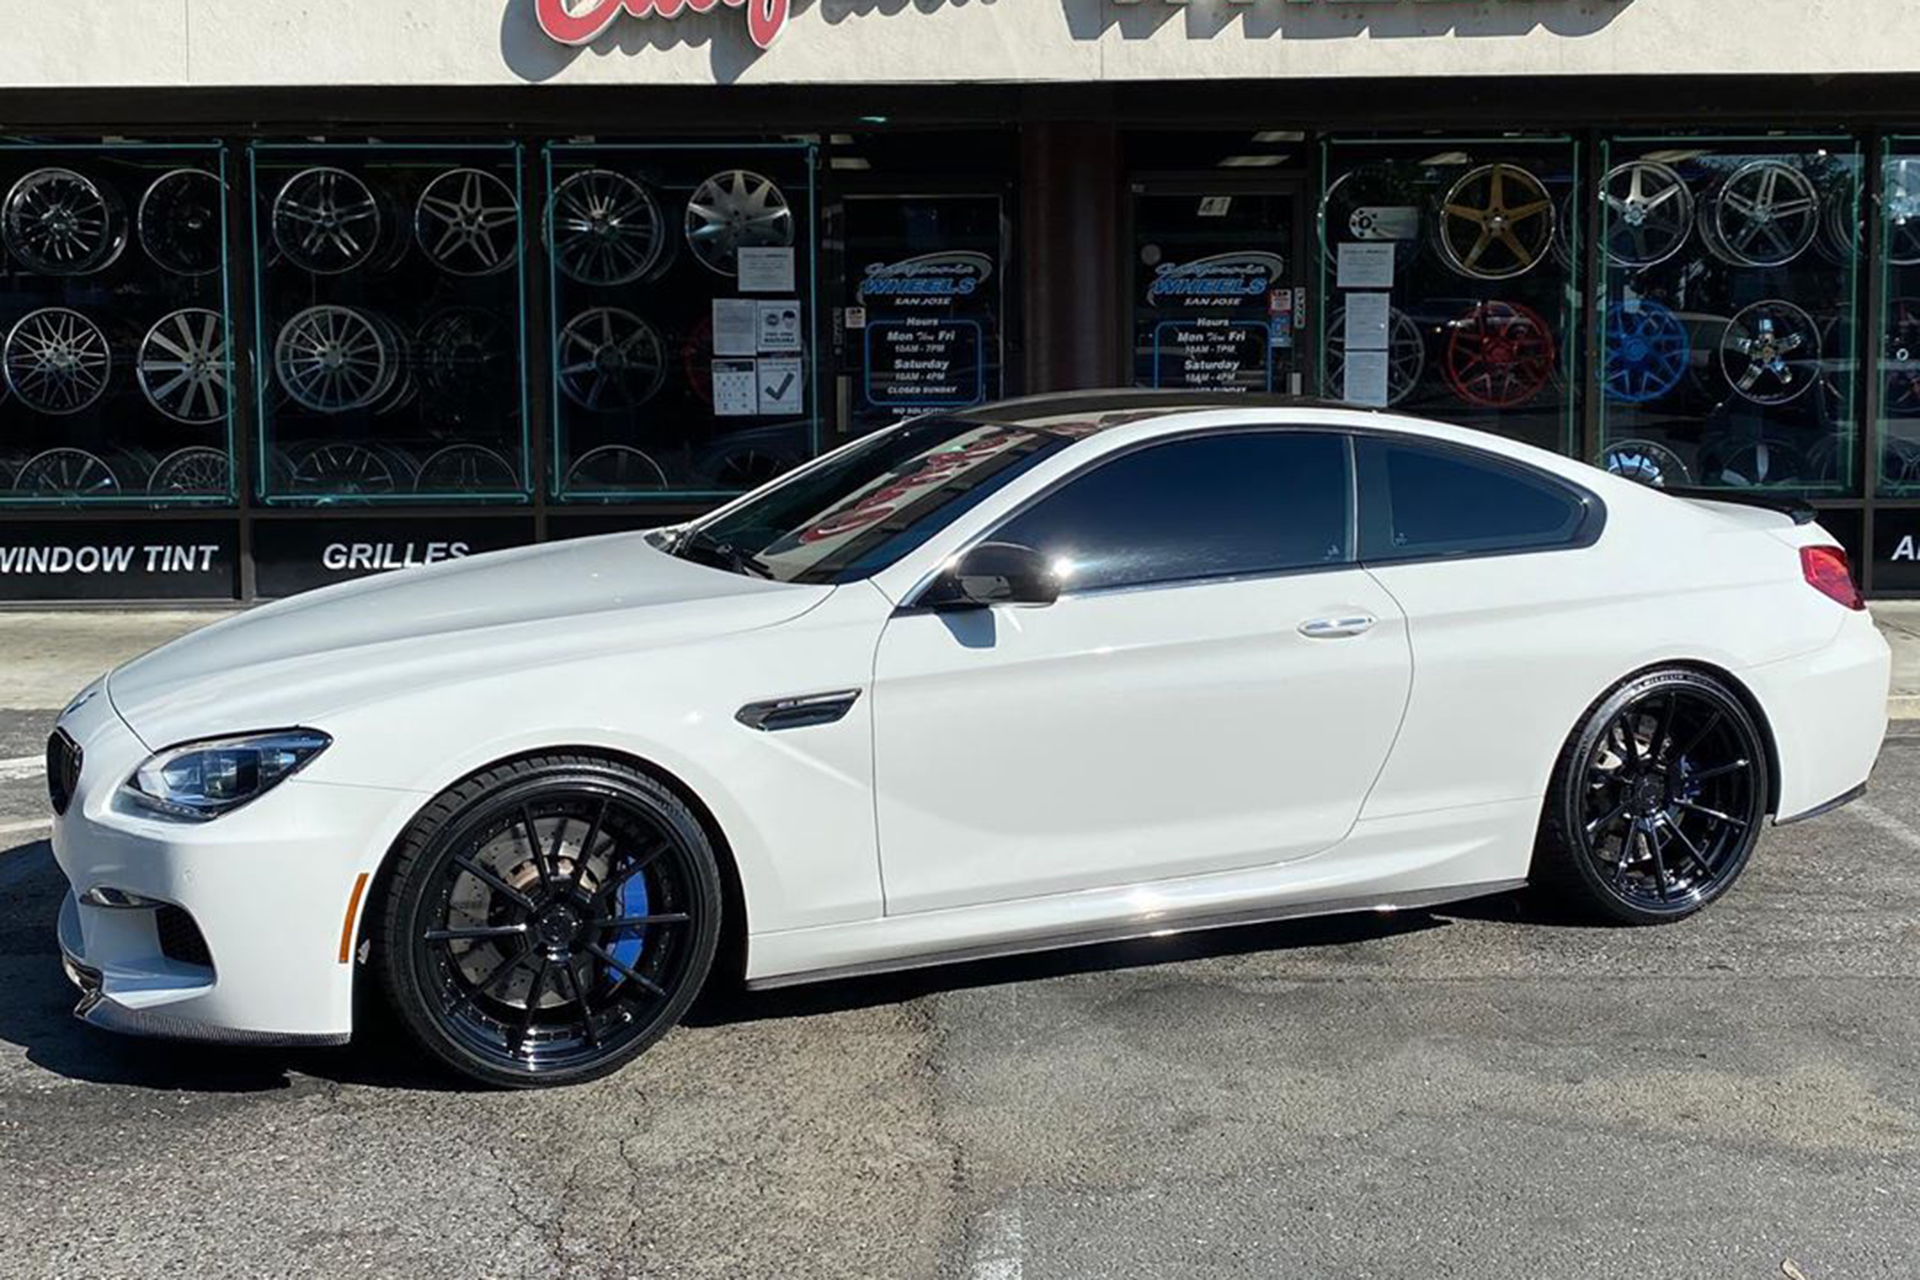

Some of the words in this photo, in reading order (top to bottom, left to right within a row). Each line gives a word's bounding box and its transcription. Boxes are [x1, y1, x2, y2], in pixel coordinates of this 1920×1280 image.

[863, 277, 976, 295] WHEELS
[1154, 277, 1267, 295] WHEELS
[895, 297, 918, 306] SAN
[920, 297, 952, 306] JOSE
[1184, 297, 1209, 306] SAN
[1211, 297, 1243, 306] JOSE
[906, 317, 939, 327] Hours
[1197, 318, 1229, 327] Hours
[887, 331, 913, 341] Mon
[938, 330, 955, 341] Fri
[1177, 331, 1204, 342] Mon
[1228, 331, 1246, 341] Fri
[895, 344, 918, 353] 10AM
[926, 344, 945, 353] 7PM
[894, 359, 950, 371] Saturday
[1184, 360, 1240, 371] Saturday
[926, 372, 945, 381] 4PM
[887, 385, 921, 394] CLOSED
[922, 385, 957, 394] SUNDAY
[143, 545, 218, 572] TINT
[323, 542, 469, 569] GRILLES
